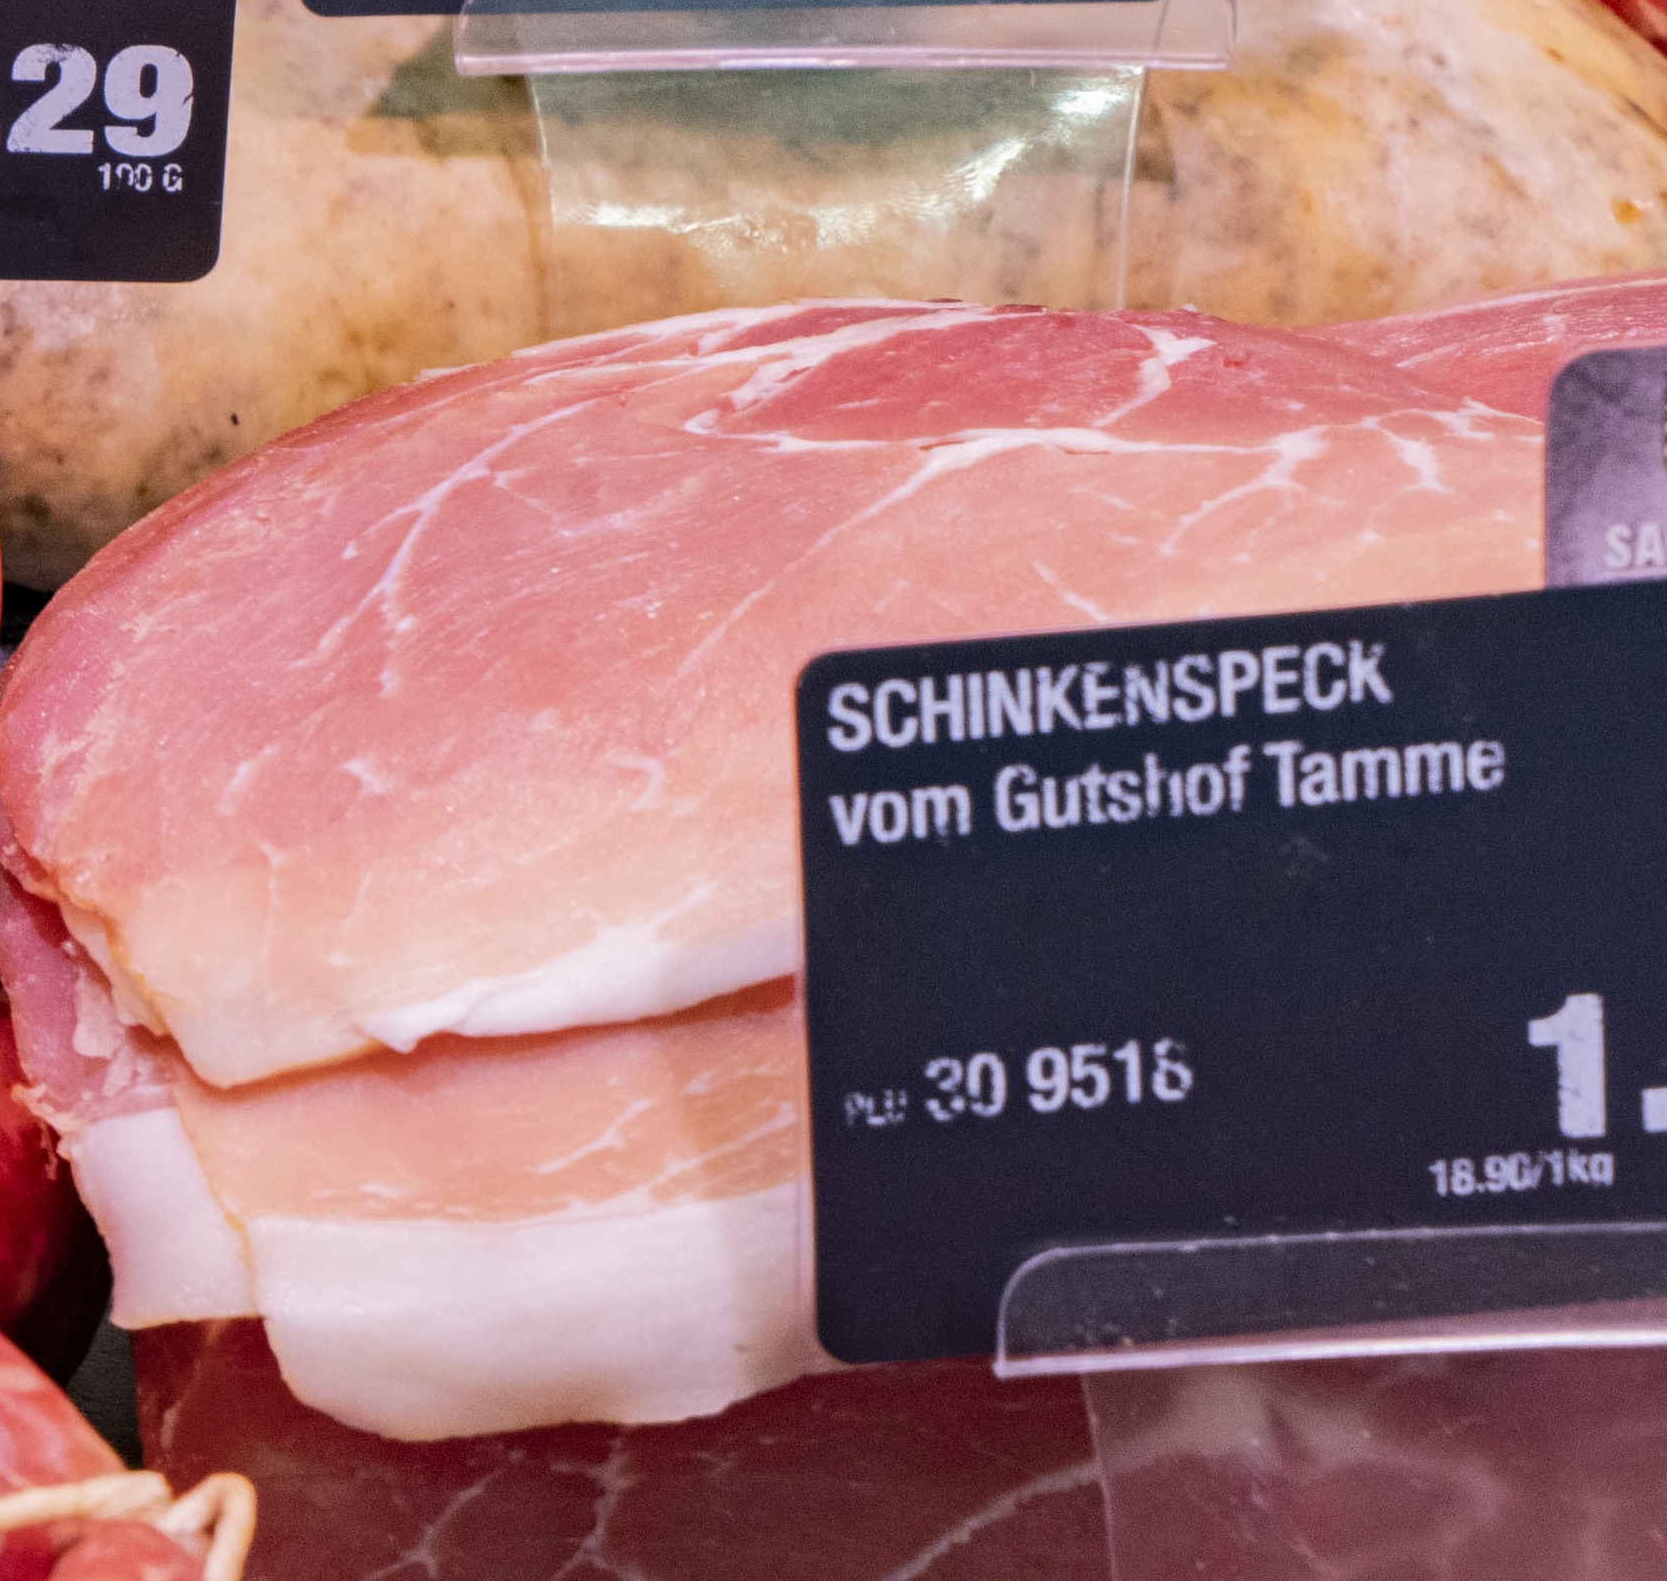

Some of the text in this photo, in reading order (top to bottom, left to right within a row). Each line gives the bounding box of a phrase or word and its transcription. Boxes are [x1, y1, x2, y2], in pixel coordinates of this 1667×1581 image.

[828, 641, 1393, 752] SCHINKENSPECK
[830, 738, 1506, 846] vom Gutshof Tamme
[1428, 1149, 1615, 1197] 18.90/1kg
